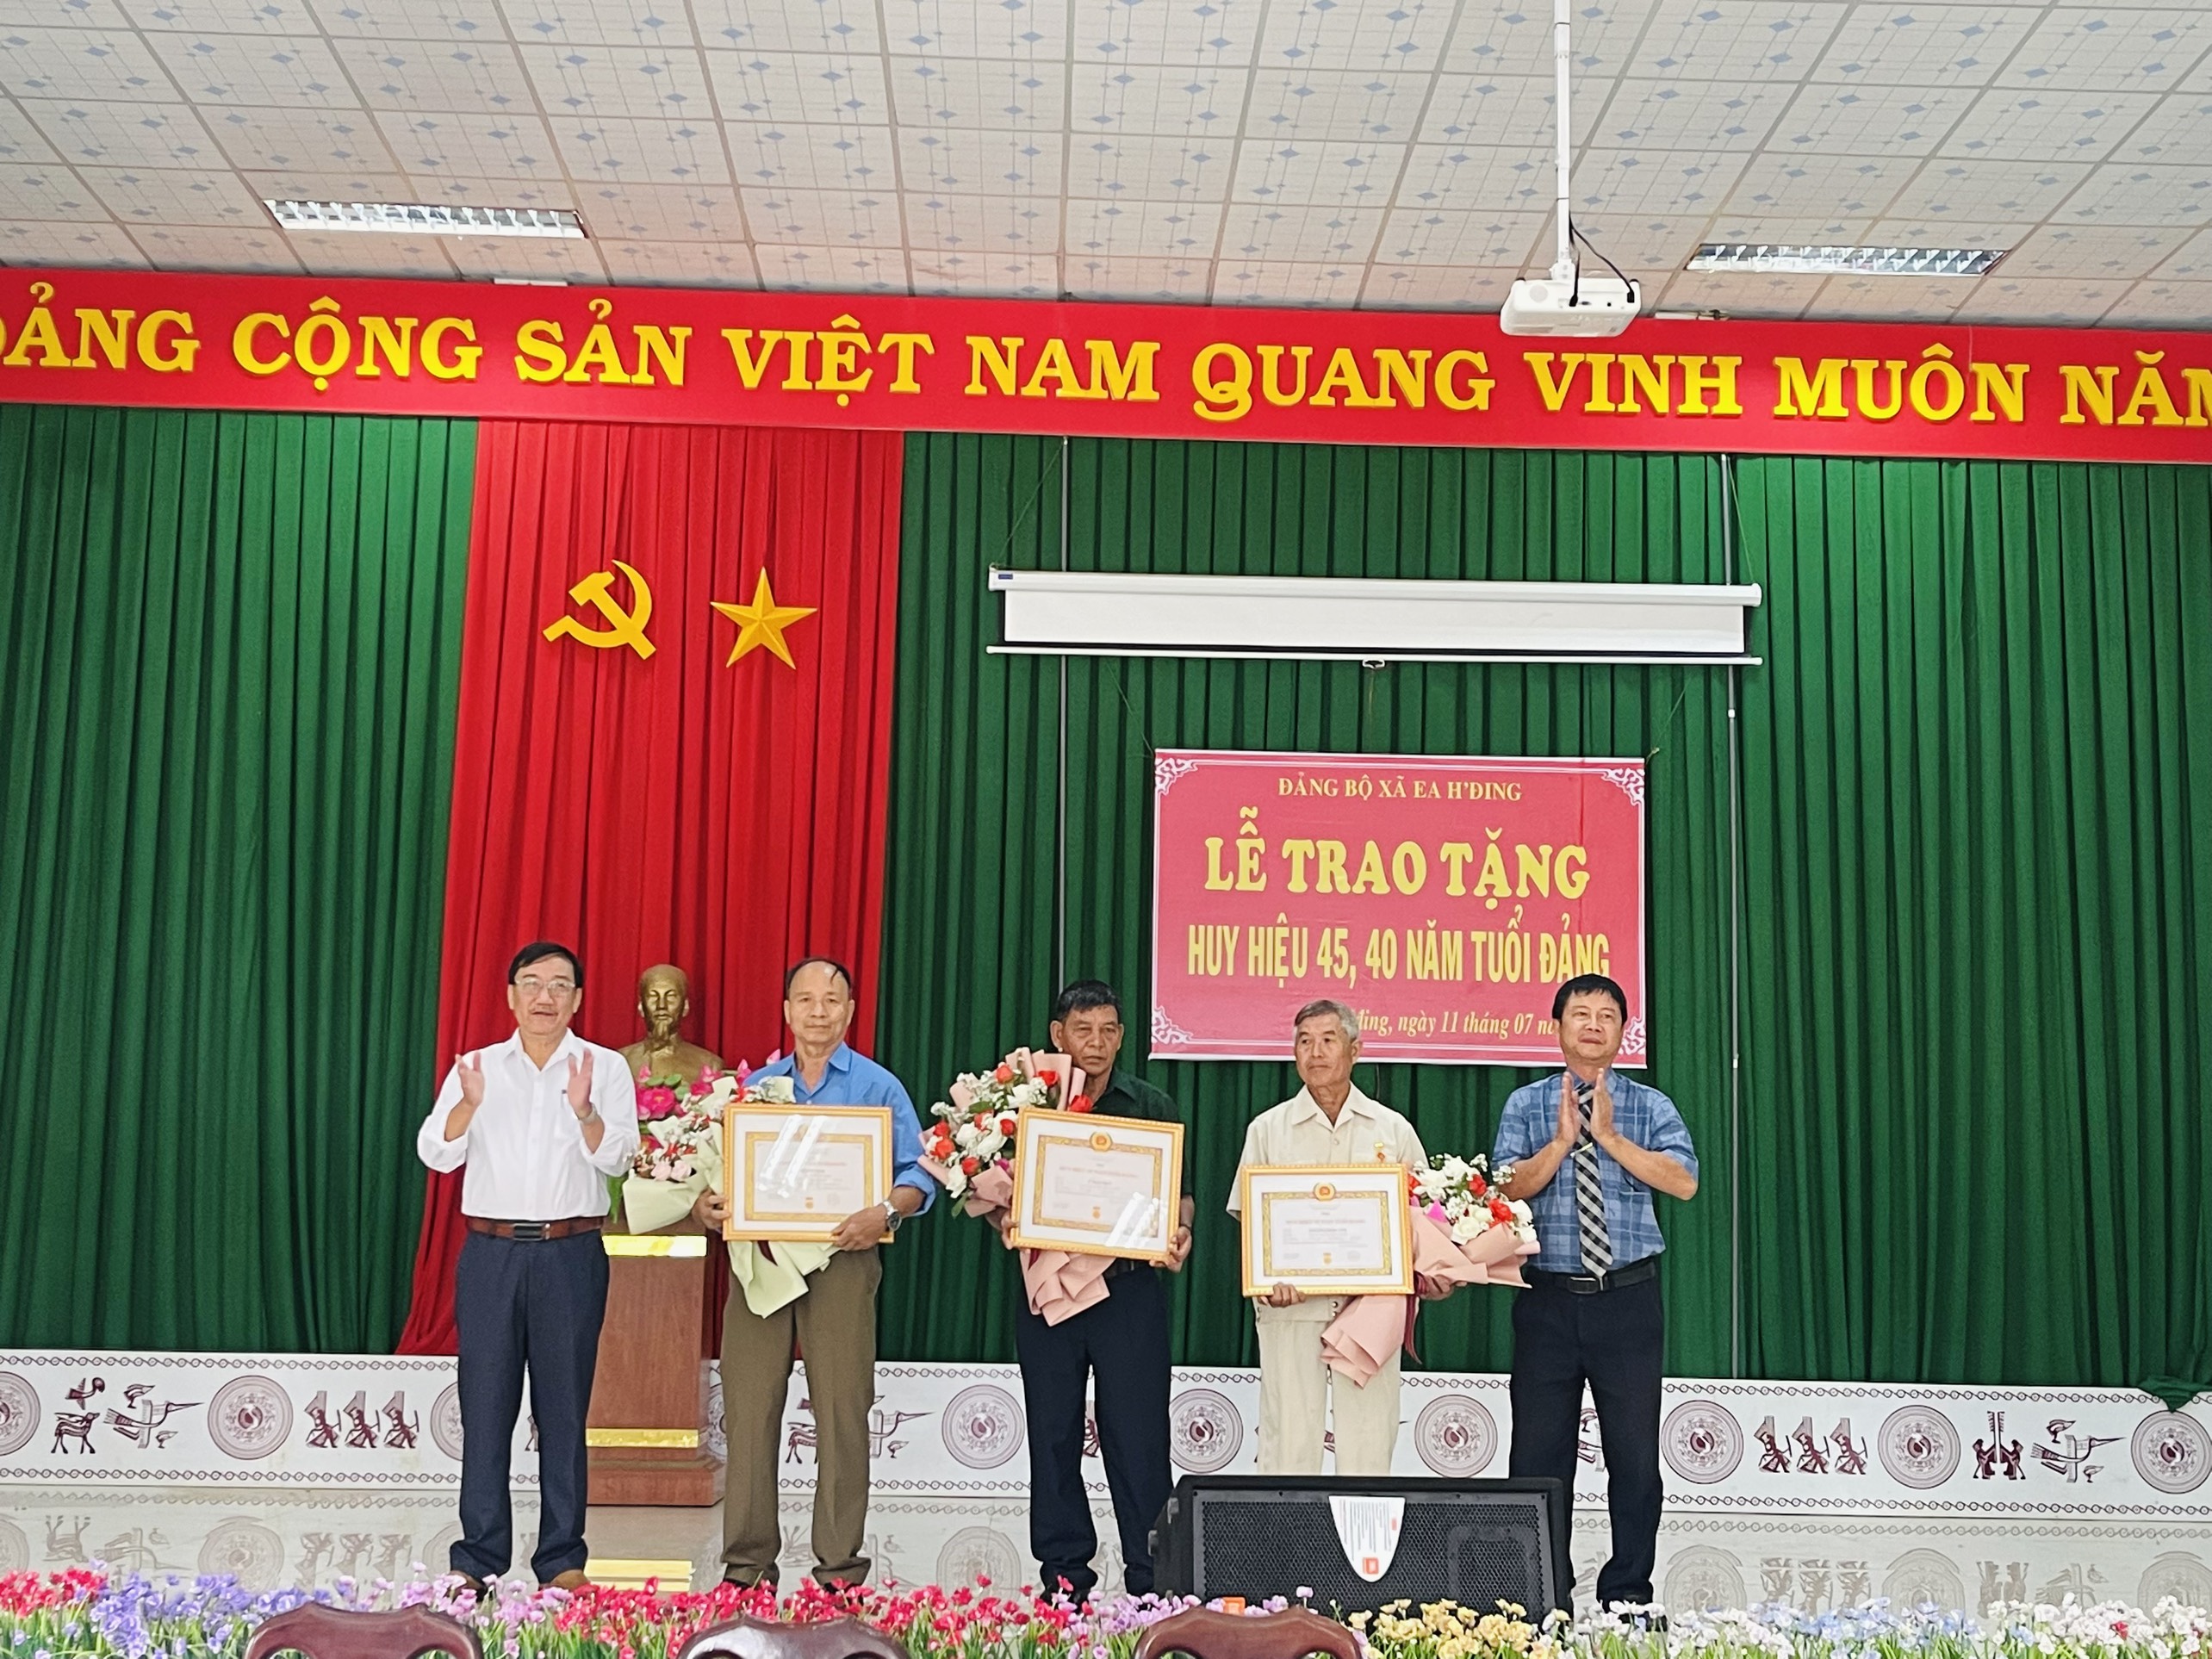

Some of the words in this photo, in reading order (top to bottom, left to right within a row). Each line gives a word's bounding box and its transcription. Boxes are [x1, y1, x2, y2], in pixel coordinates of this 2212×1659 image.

[0, 282, 200, 371] ẢNG
[233, 296, 484, 391] CỘNG
[514, 298, 693, 386] SẢN
[721, 314, 935, 407] VIỆT
[964, 335, 1161, 401] NAM
[1192, 343, 1495, 420] QUANG
[1523, 351, 1743, 415] VINH
[1773, 343, 2030, 422] MUÔN
[1278, 772, 1339, 797] ĐẢNG
[1345, 774, 1373, 801] BỘ
[1379, 775, 1407, 798] XÃ
[1414, 780, 1441, 798] EA
[1204, 805, 1267, 892] LỄ
[1282, 838, 1427, 896] TRAO
[1439, 827, 1591, 910] TẶNG
[1188, 924, 1240, 977] HUY
[1248, 913, 1308, 988] HIỆU
[1316, 927, 1357, 990] 45,
[1364, 928, 1398, 980] 40
[1406, 919, 1463, 981] NĂM
[1470, 904, 1531, 984] TUỔI
[1539, 912, 1610, 984] ĐẢNG
[1397, 1010, 1436, 1037] ngày
[1440, 1011, 1458, 1033] 11
[1463, 1011, 1509, 1040] tháng
[1513, 1013, 1534, 1035] 07
